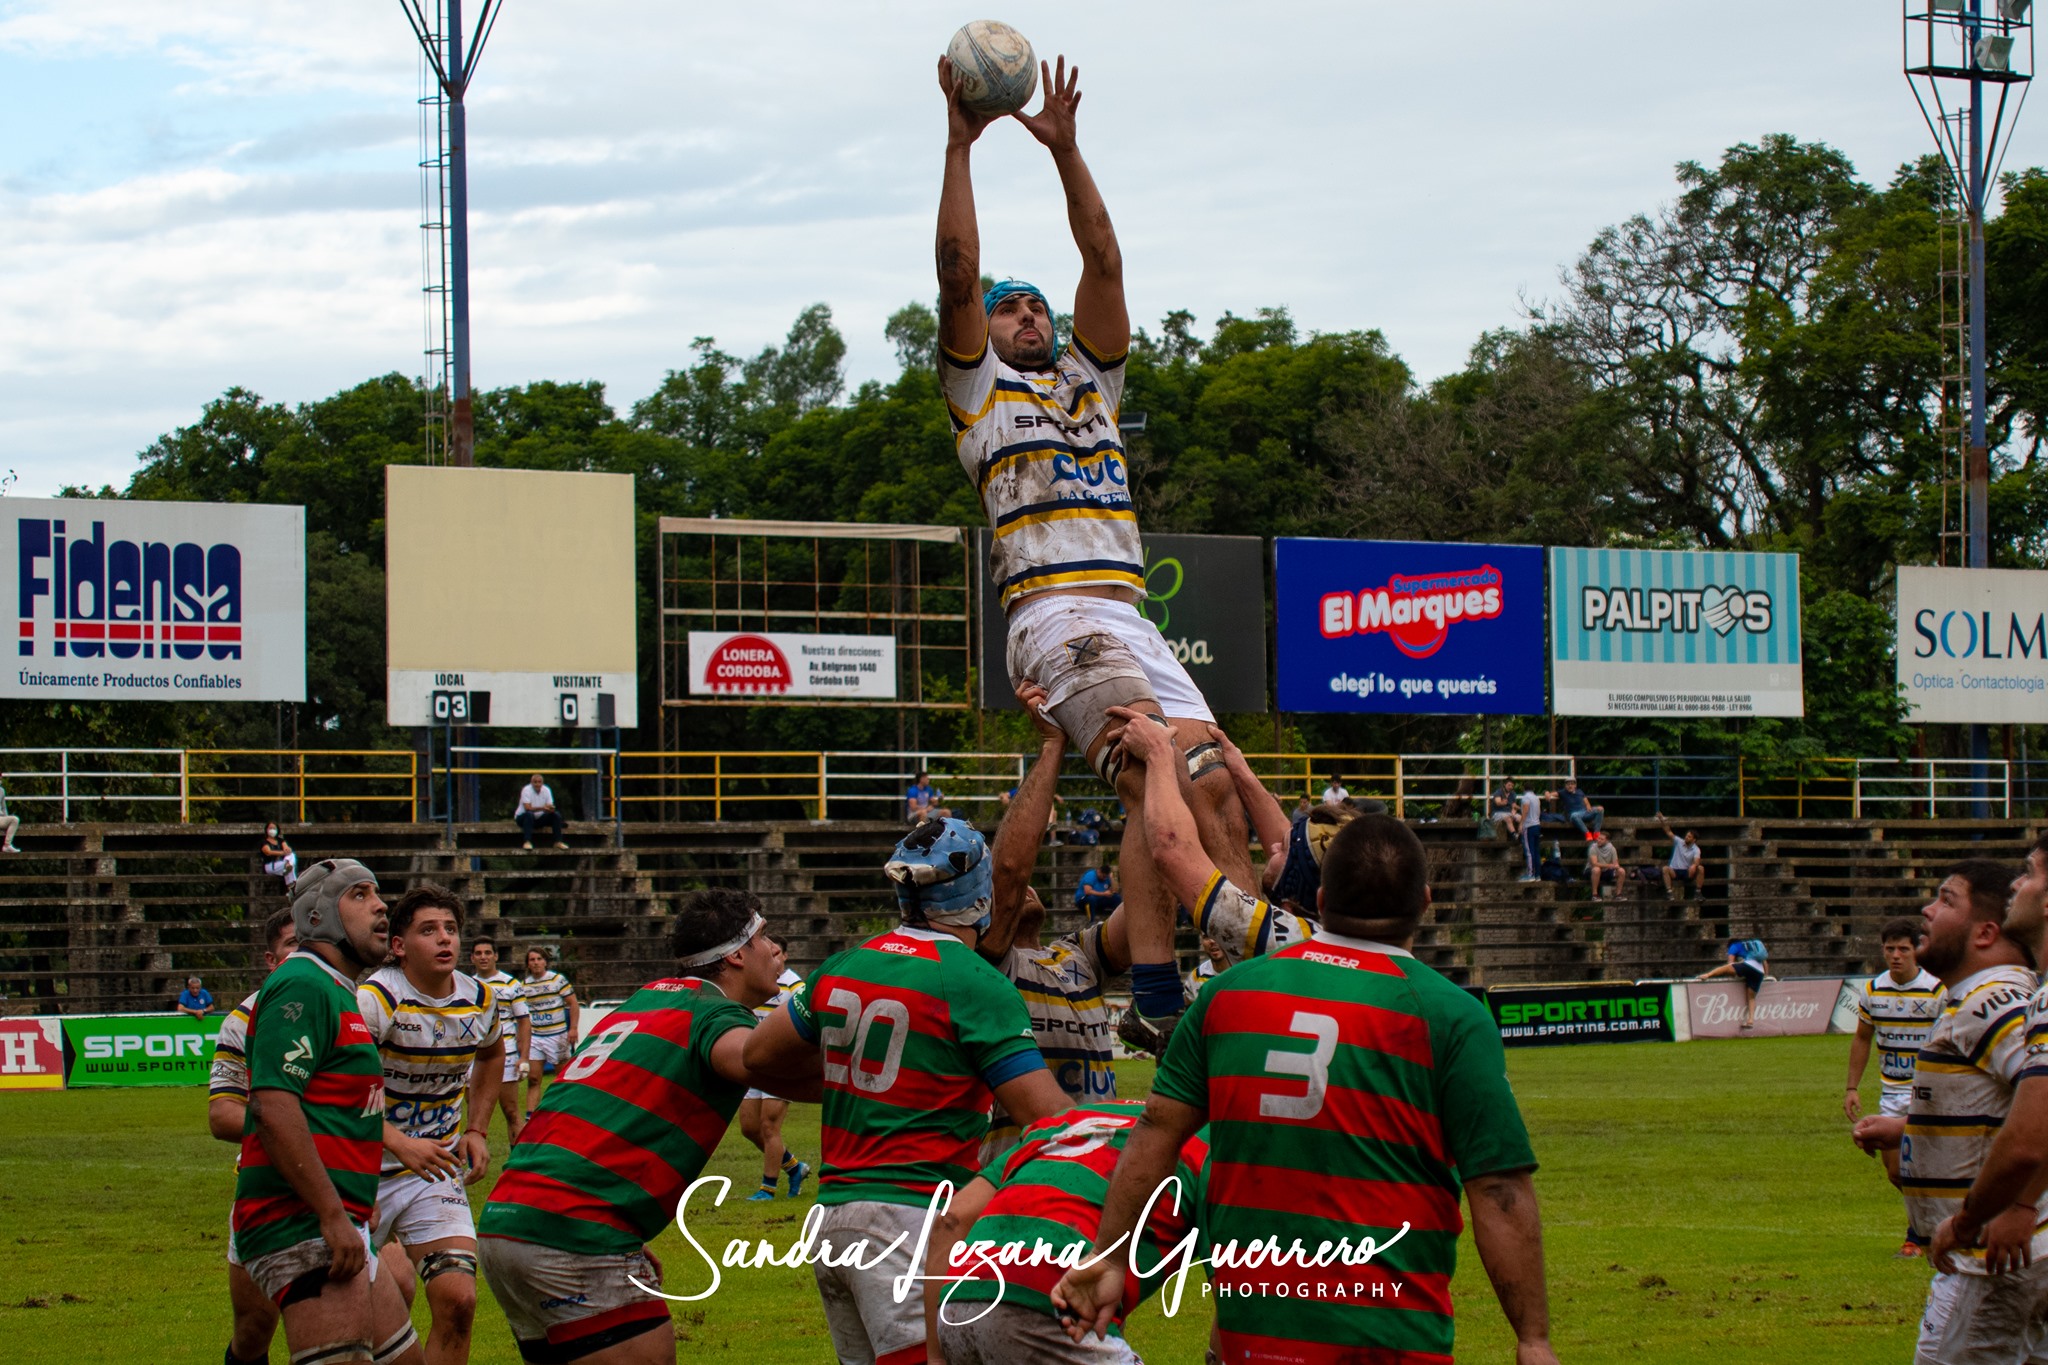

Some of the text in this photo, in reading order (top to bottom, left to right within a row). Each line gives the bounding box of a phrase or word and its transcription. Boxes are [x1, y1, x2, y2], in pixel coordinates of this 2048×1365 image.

[18, 518, 242, 660] Fidensa
[1393, 570, 1498, 595] Supermercado
[1323, 587, 1500, 633] El Marques
[722, 648, 775, 662] LONERA
[801, 645, 835, 656] Nuestras
[821, 661, 857, 673] Belgrano
[859, 662, 877, 673] 1440
[19, 668, 242, 689] Únicamente Productos Confiables
[435, 674, 465, 686] LOCAL
[553, 676, 602, 688] VISITANTE
[809, 674, 860, 686] Córdoba 660
[1330, 672, 1497, 700] elegí lo que querés
[1913, 673, 1954, 691] Optica
[1614, 703, 1640, 711] NECESITA
[1640, 703, 1658, 711] AYUDA
[1616, 694, 1633, 702] JUEGO
[1634, 694, 1669, 702] COMPULSIVO
[1677, 695, 1711, 703] PERJUDICIAL
[1712, 695, 1726, 703] PARA
[1727, 695, 1733, 703] LA
[1734, 695, 1752, 703] SALUD
[563, 698, 577, 720] 0
[1301, 950, 1360, 970] PROCER
[1500, 997, 1660, 1025] SPORTING
[1501, 1019, 1661, 1038] WWW.SPORTING.COM.AR
[563, 1020, 639, 1081] 8
[820, 988, 910, 1093] 20
[1259, 1011, 1340, 1120] 3
